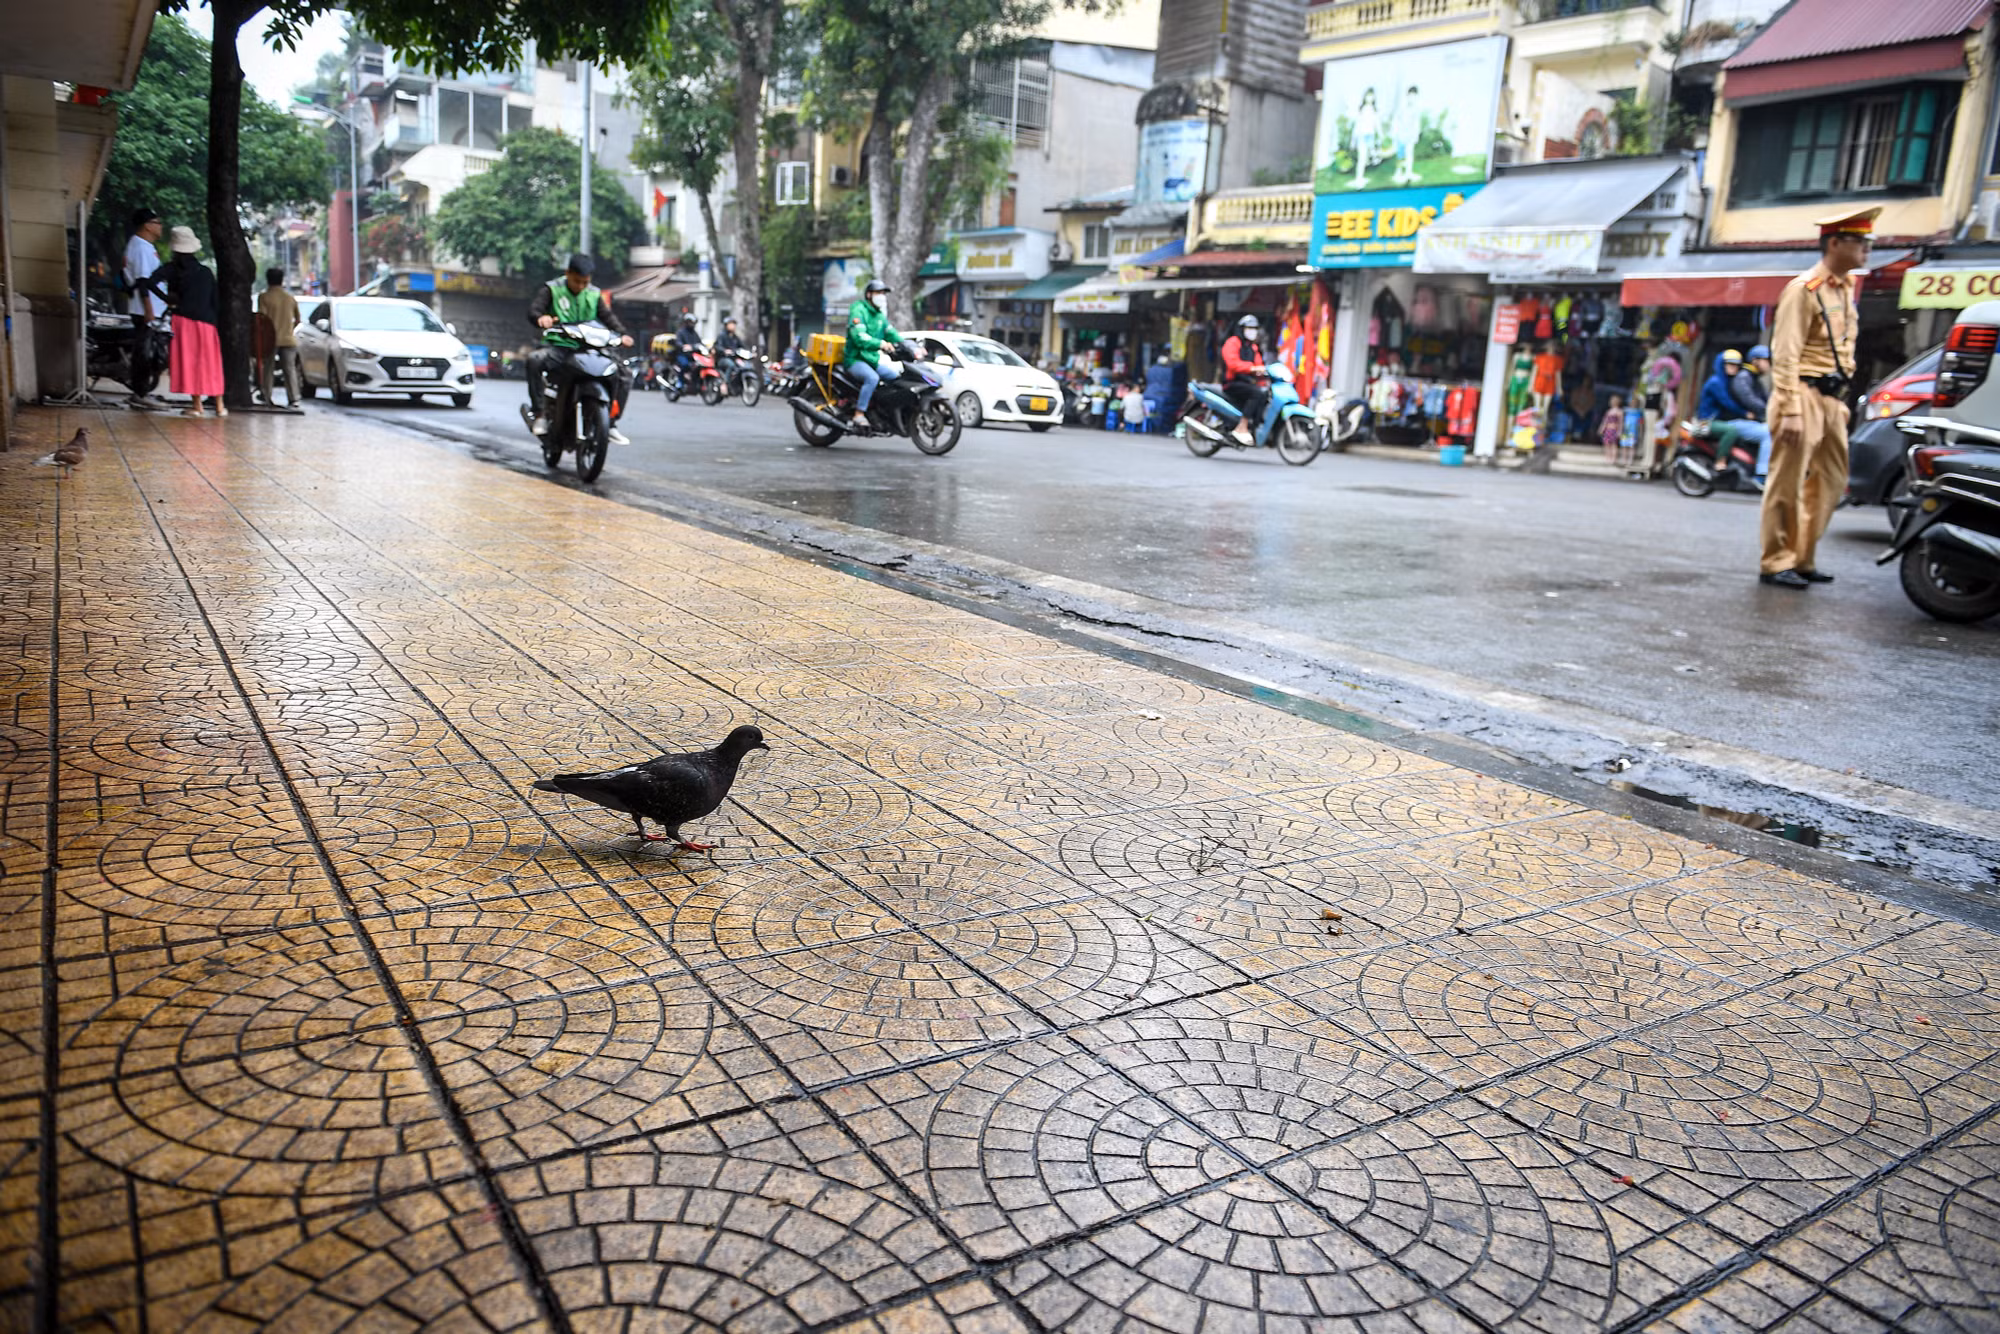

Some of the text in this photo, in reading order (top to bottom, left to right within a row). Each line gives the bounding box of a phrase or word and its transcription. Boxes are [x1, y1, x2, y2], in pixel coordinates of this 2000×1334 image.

[1326, 206, 1437, 240] BEE KIDS
[1916, 275, 1954, 295] 28
